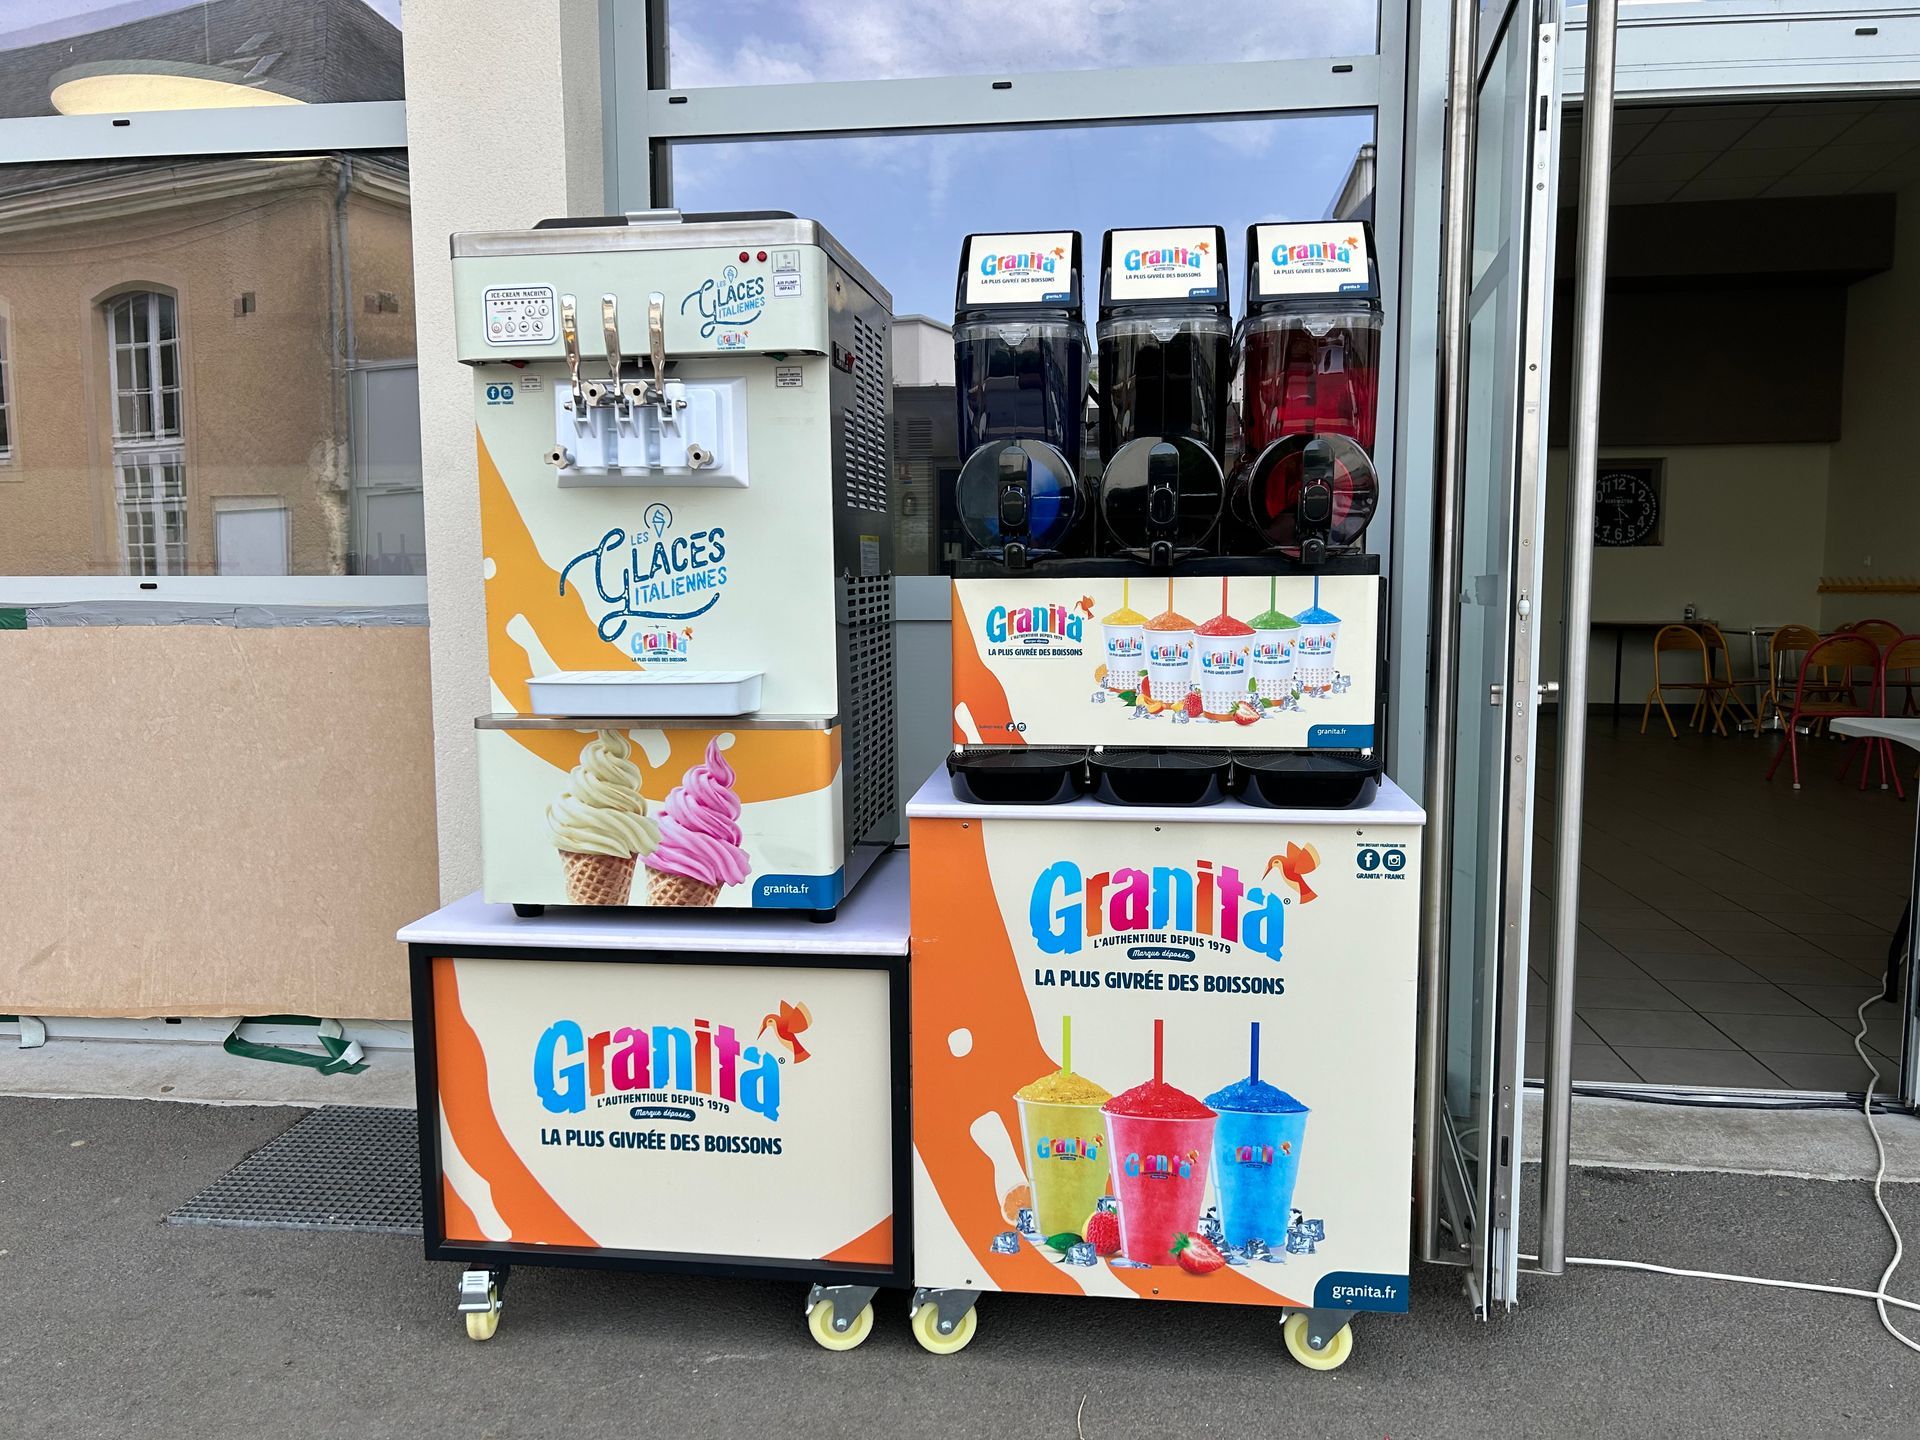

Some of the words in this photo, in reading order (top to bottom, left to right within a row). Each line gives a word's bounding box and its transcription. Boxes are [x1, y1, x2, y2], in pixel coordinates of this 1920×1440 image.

[1124, 246, 1200, 272] Granita
[1271, 241, 1350, 267] Granita
[980, 251, 1055, 276] Granita
[716, 280, 726, 288] LES
[719, 296, 765, 319] ITALIENNES
[1601, 480, 1611, 493] 11
[1613, 478, 1626, 490] 12
[1629, 481, 1635, 494] 1
[1638, 489, 1646, 502] 2
[1642, 502, 1650, 515] 3
[1637, 515, 1645, 528] 4
[1602, 525, 1611, 537] 7
[1614, 527, 1623, 540] 6
[1627, 524, 1635, 537] 5
[630, 531, 649, 546] LES
[635, 566, 728, 606] ITALIENNES
[985, 603, 1083, 643] Granita
[630, 631, 687, 654] Granita
[988, 648, 997, 656] LA
[998, 648, 1014, 656] PLUS
[1015, 647, 1038, 656] GIVRÉE
[1039, 648, 1051, 656] DES
[1052, 648, 1083, 656] BOISSONS
[1317, 727, 1347, 736] granita.fr
[763, 883, 809, 896] granita.fr
[1093, 933, 1168, 949] L'AUTHENTIQUE
[1170, 934, 1205, 948] DEPUIS
[1207, 940, 1231, 954] 1979
[1132, 948, 1161, 959] Marque
[1161, 948, 1191, 960] déposée
[1034, 968, 1056, 987] LA
[1060, 969, 1100, 988] PLUS
[1104, 969, 1164, 990] GIVRÉE
[1168, 974, 1199, 992] DES
[1203, 975, 1285, 995] BOISSONS
[597, 1093, 668, 1108] L'AUTHENTIQUE
[671, 1093, 704, 1107] DEPUIS
[707, 1099, 730, 1114] 1979
[634, 1108, 662, 1118] Marque
[662, 1108, 691, 1120] déposée
[540, 1128, 562, 1146] LA
[565, 1128, 605, 1148] PLUS
[608, 1129, 667, 1150] GIVRÉE
[670, 1133, 700, 1152] DES
[704, 1134, 783, 1156] BOISSONS
[1037, 1136, 1097, 1162] Granita
[1331, 1283, 1397, 1301] granita.fr
